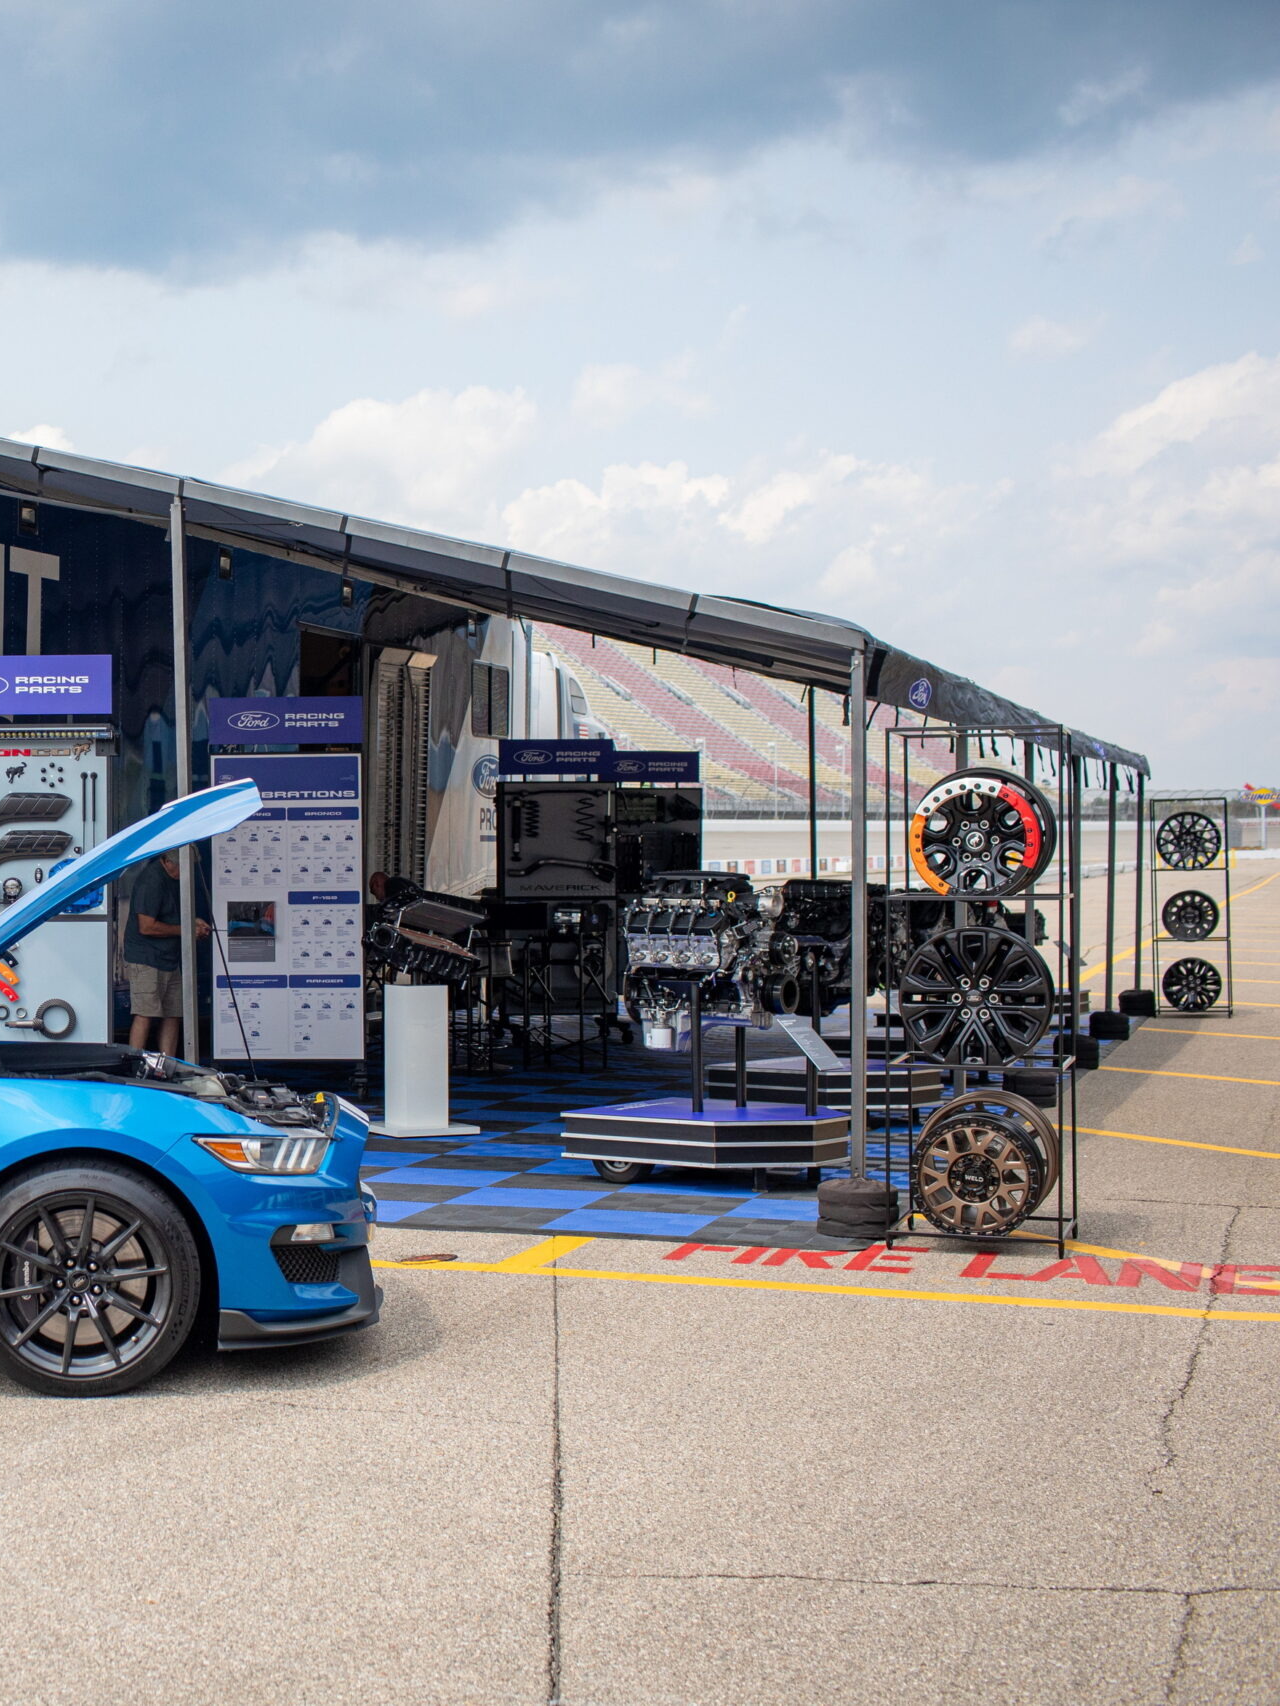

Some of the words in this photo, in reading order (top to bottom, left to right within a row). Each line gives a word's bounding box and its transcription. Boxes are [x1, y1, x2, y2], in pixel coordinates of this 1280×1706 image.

[15, 675, 89, 684] RACING
[15, 685, 83, 694] PARTS
[237, 713, 269, 728] Ford
[284, 712, 345, 720] RACING
[284, 720, 339, 728] PARTS
[520, 751, 546, 763] Ford
[615, 761, 640, 773] Ford
[520, 884, 601, 892] MAVERICK
[964, 1174, 984, 1183] WELD
[662, 1241, 930, 1274] FIRE
[959, 1251, 1280, 1296] LANE
